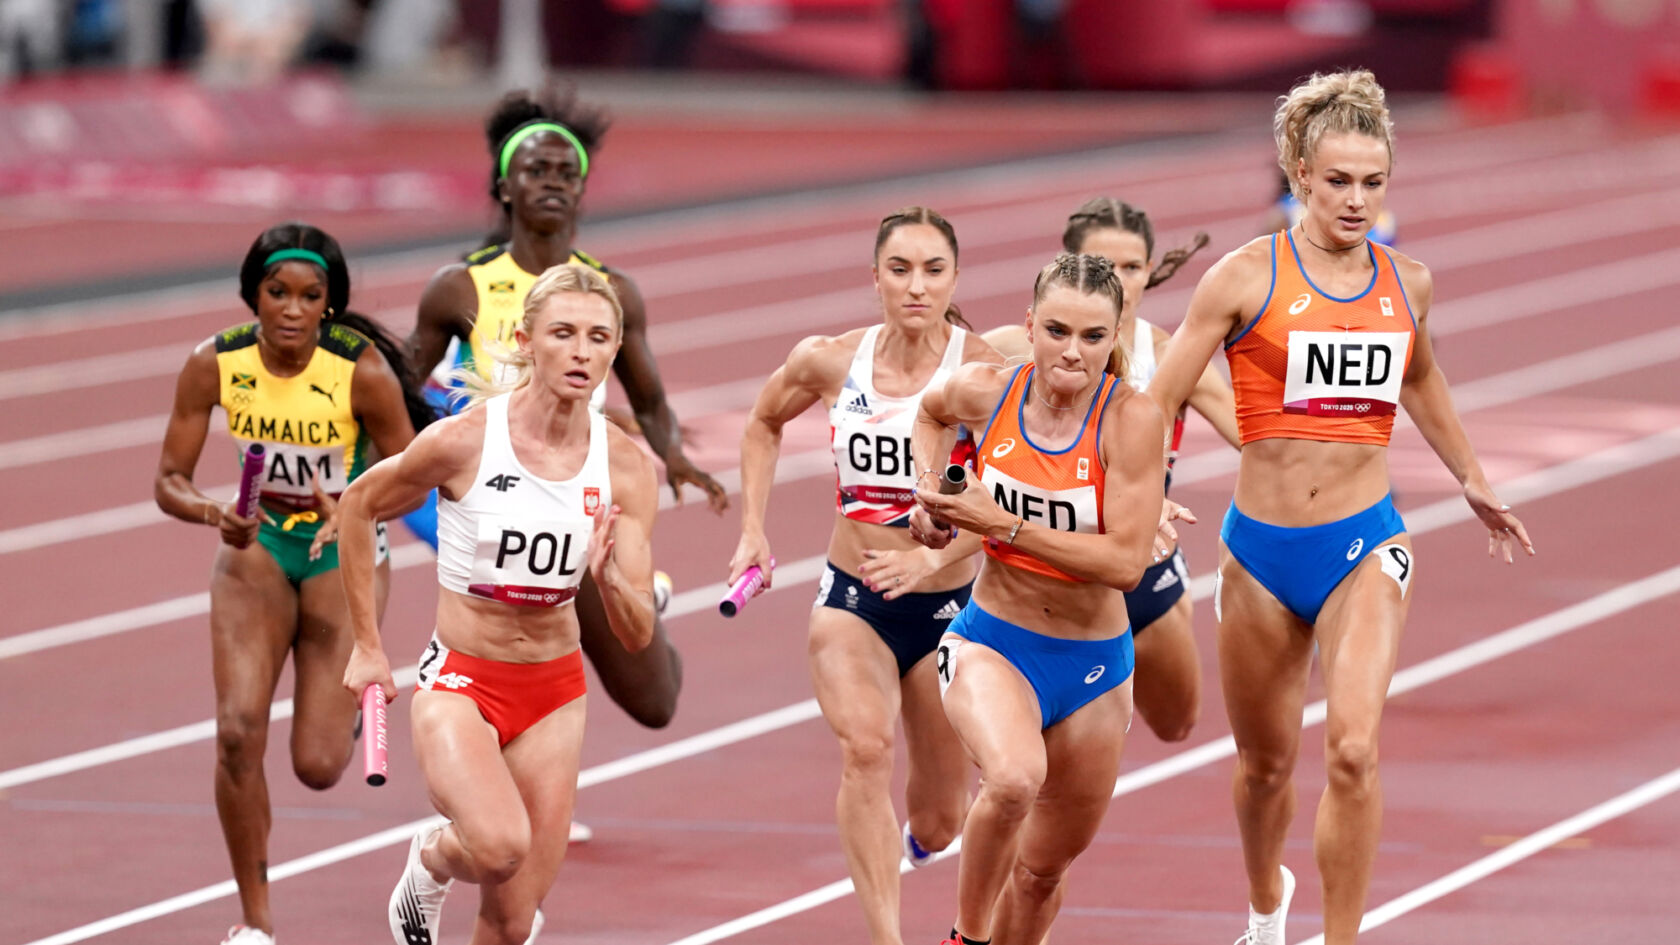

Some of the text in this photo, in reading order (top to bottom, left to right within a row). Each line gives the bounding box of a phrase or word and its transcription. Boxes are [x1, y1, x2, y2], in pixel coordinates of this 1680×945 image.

[1305, 343, 1392, 386] NED
[845, 405, 873, 415] adidas
[1320, 403, 1339, 411] TOKYO
[231, 412, 340, 444] JAMAICA
[267, 452, 332, 487] AM
[485, 474, 521, 492] 4F
[865, 490, 897, 500] TOKYO 2020
[495, 529, 577, 577] POL
[1389, 547, 1409, 582] 9
[506, 590, 543, 601] TOKYO 2020
[419, 640, 440, 683] 2
[937, 645, 950, 683] 9
[437, 672, 474, 689] 4F
